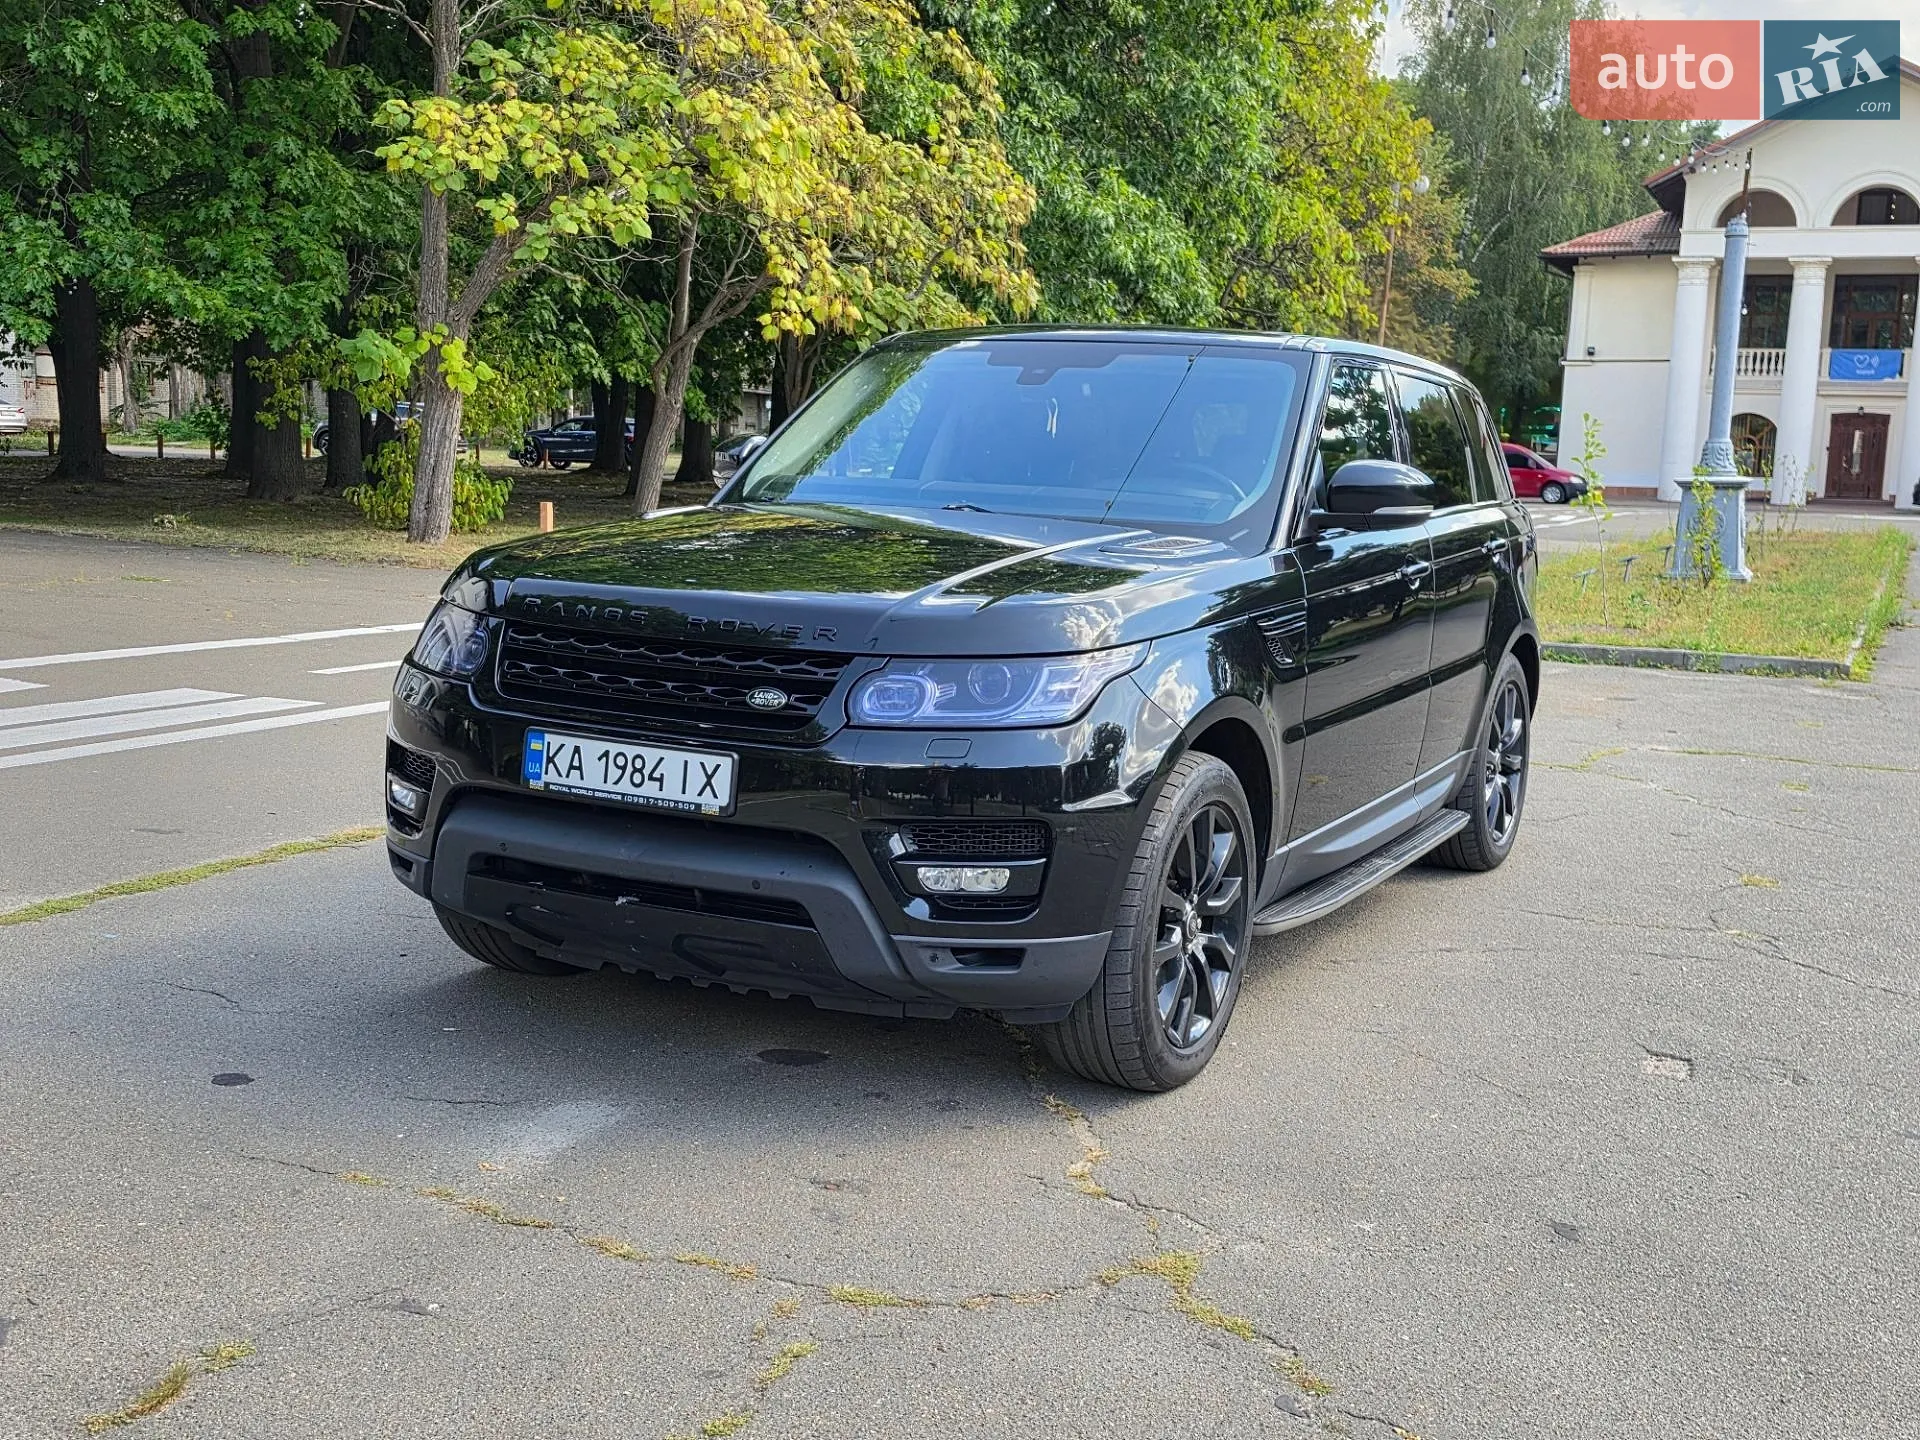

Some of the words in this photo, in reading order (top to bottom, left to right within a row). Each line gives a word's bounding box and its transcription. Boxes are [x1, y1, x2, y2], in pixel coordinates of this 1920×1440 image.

[521, 597, 649, 625] RANGE
[686, 616, 838, 642] ROVER
[753, 691, 773, 699] LAND
[754, 698, 779, 707] ROVER
[528, 761, 541, 774] UA
[544, 740, 585, 781] KA
[597, 749, 665, 792] 1984
[681, 759, 722, 800] IX
[549, 784, 570, 793] ROYAL
[571, 788, 593, 796] WORLD
